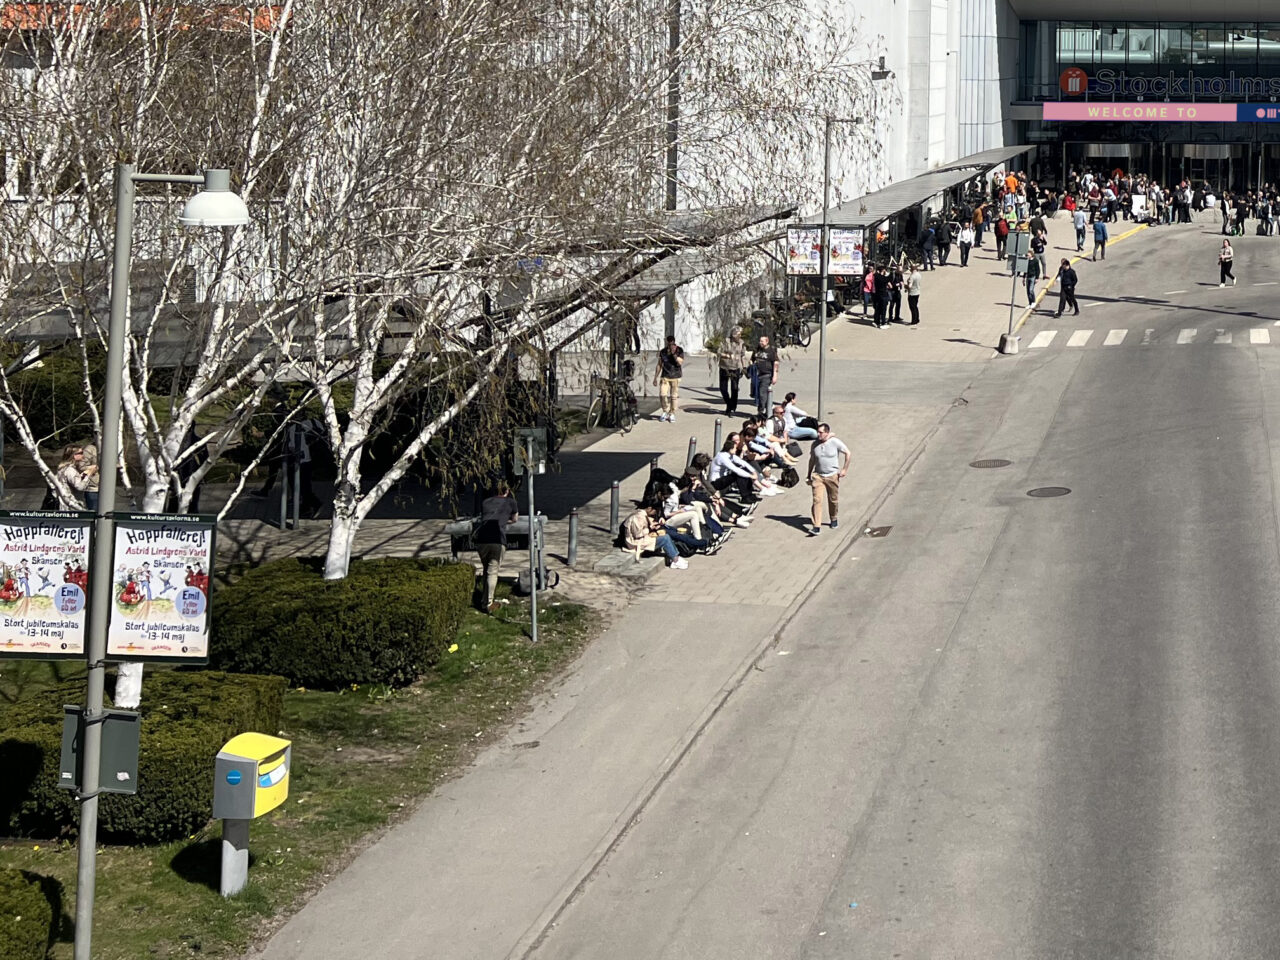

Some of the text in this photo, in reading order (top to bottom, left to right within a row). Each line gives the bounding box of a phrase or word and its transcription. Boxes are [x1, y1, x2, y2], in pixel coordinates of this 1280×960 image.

[1088, 107, 1197, 118] WELCOME TO
[4, 522, 84, 544] Hoppfallerej!
[126, 525, 206, 547] Hoppfallerej!
[3, 543, 27, 552] Astrid
[29, 544, 66, 555] Lindgrens
[125, 546, 149, 555] Astrid
[151, 547, 187, 558] Lindgrens
[32, 556, 63, 565] Skansen
[153, 559, 184, 568] Skansen
[61, 587, 79, 597] Emil
[182, 590, 200, 600] Emil
[4, 618, 79, 630] Stort jubileumskalas
[125, 622, 200, 633] Stort jubileumskalas
[51, 630, 65, 640] maj
[172, 633, 185, 643] maj
